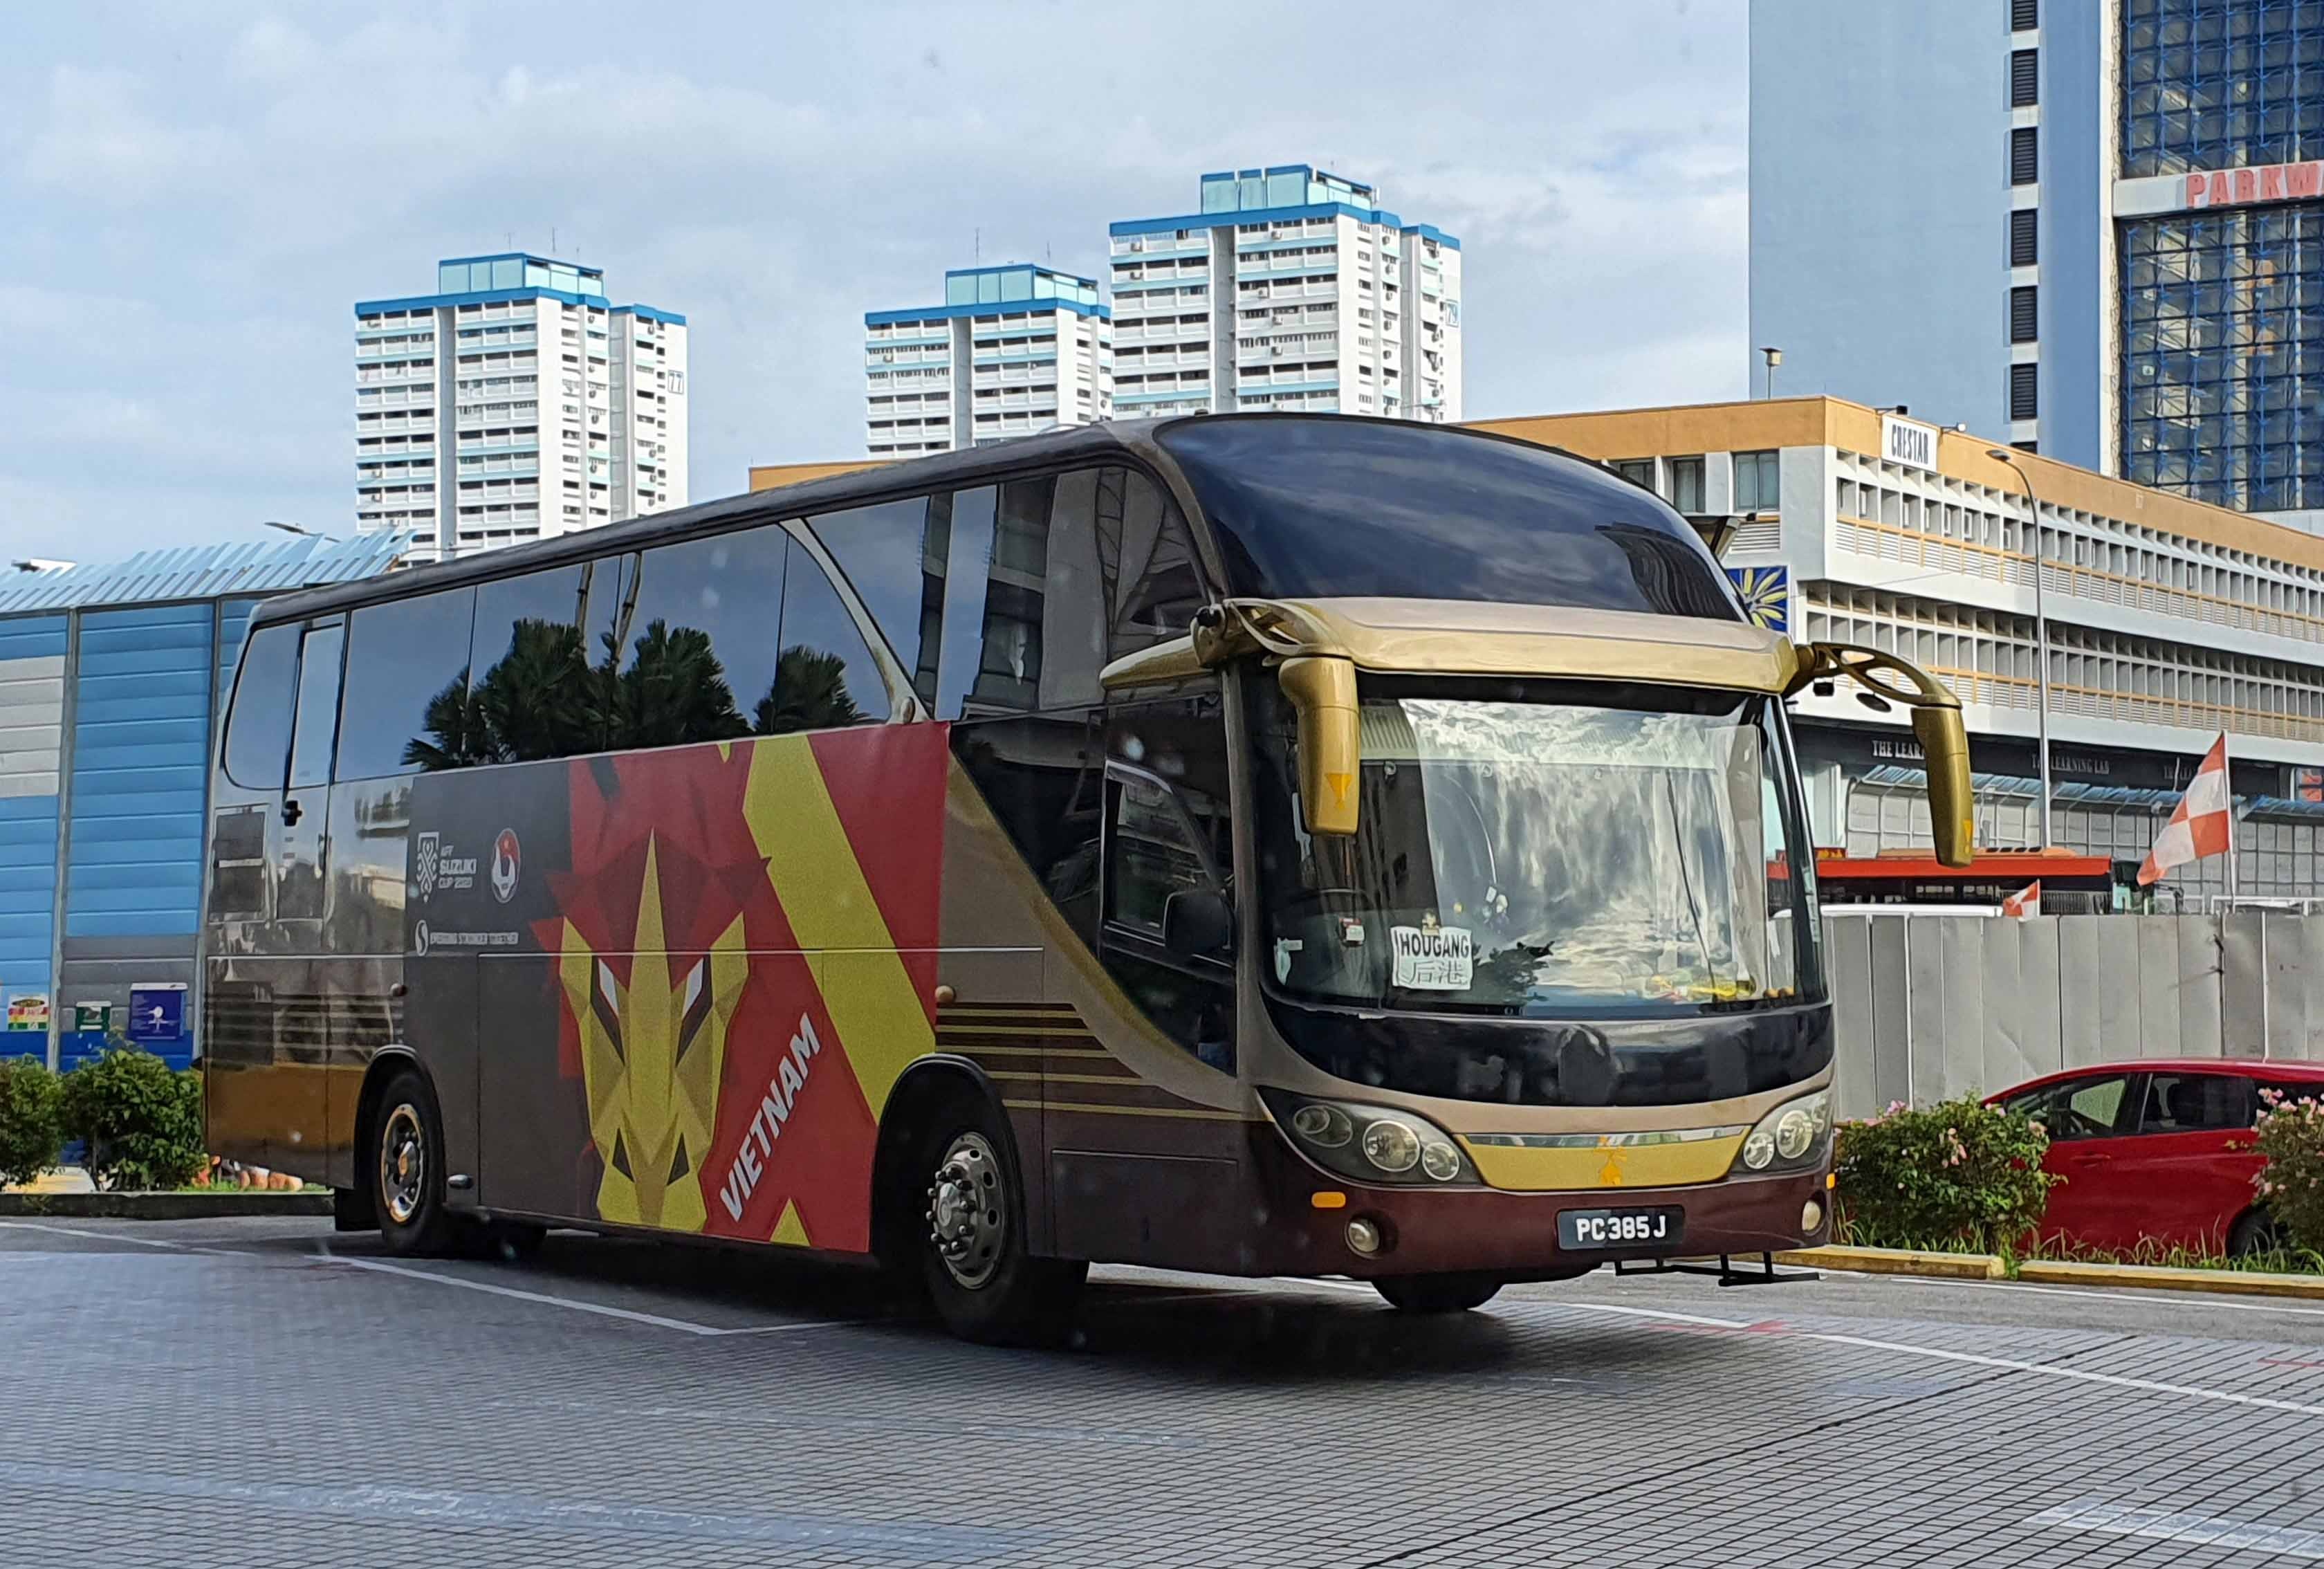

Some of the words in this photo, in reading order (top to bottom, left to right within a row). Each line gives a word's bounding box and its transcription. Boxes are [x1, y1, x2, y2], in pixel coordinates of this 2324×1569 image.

[2186, 162, 2324, 208] PARKW
[1892, 423, 1928, 464] CRESTAR
[1872, 740, 1893, 758] THE
[1895, 742, 1926, 760] LEAR
[439, 859, 477, 875] SUZUKI
[1399, 933, 1469, 958] HOUGANG
[720, 1011, 820, 1222] VIETNAM
[1576, 1215, 1666, 1242] PC385J
